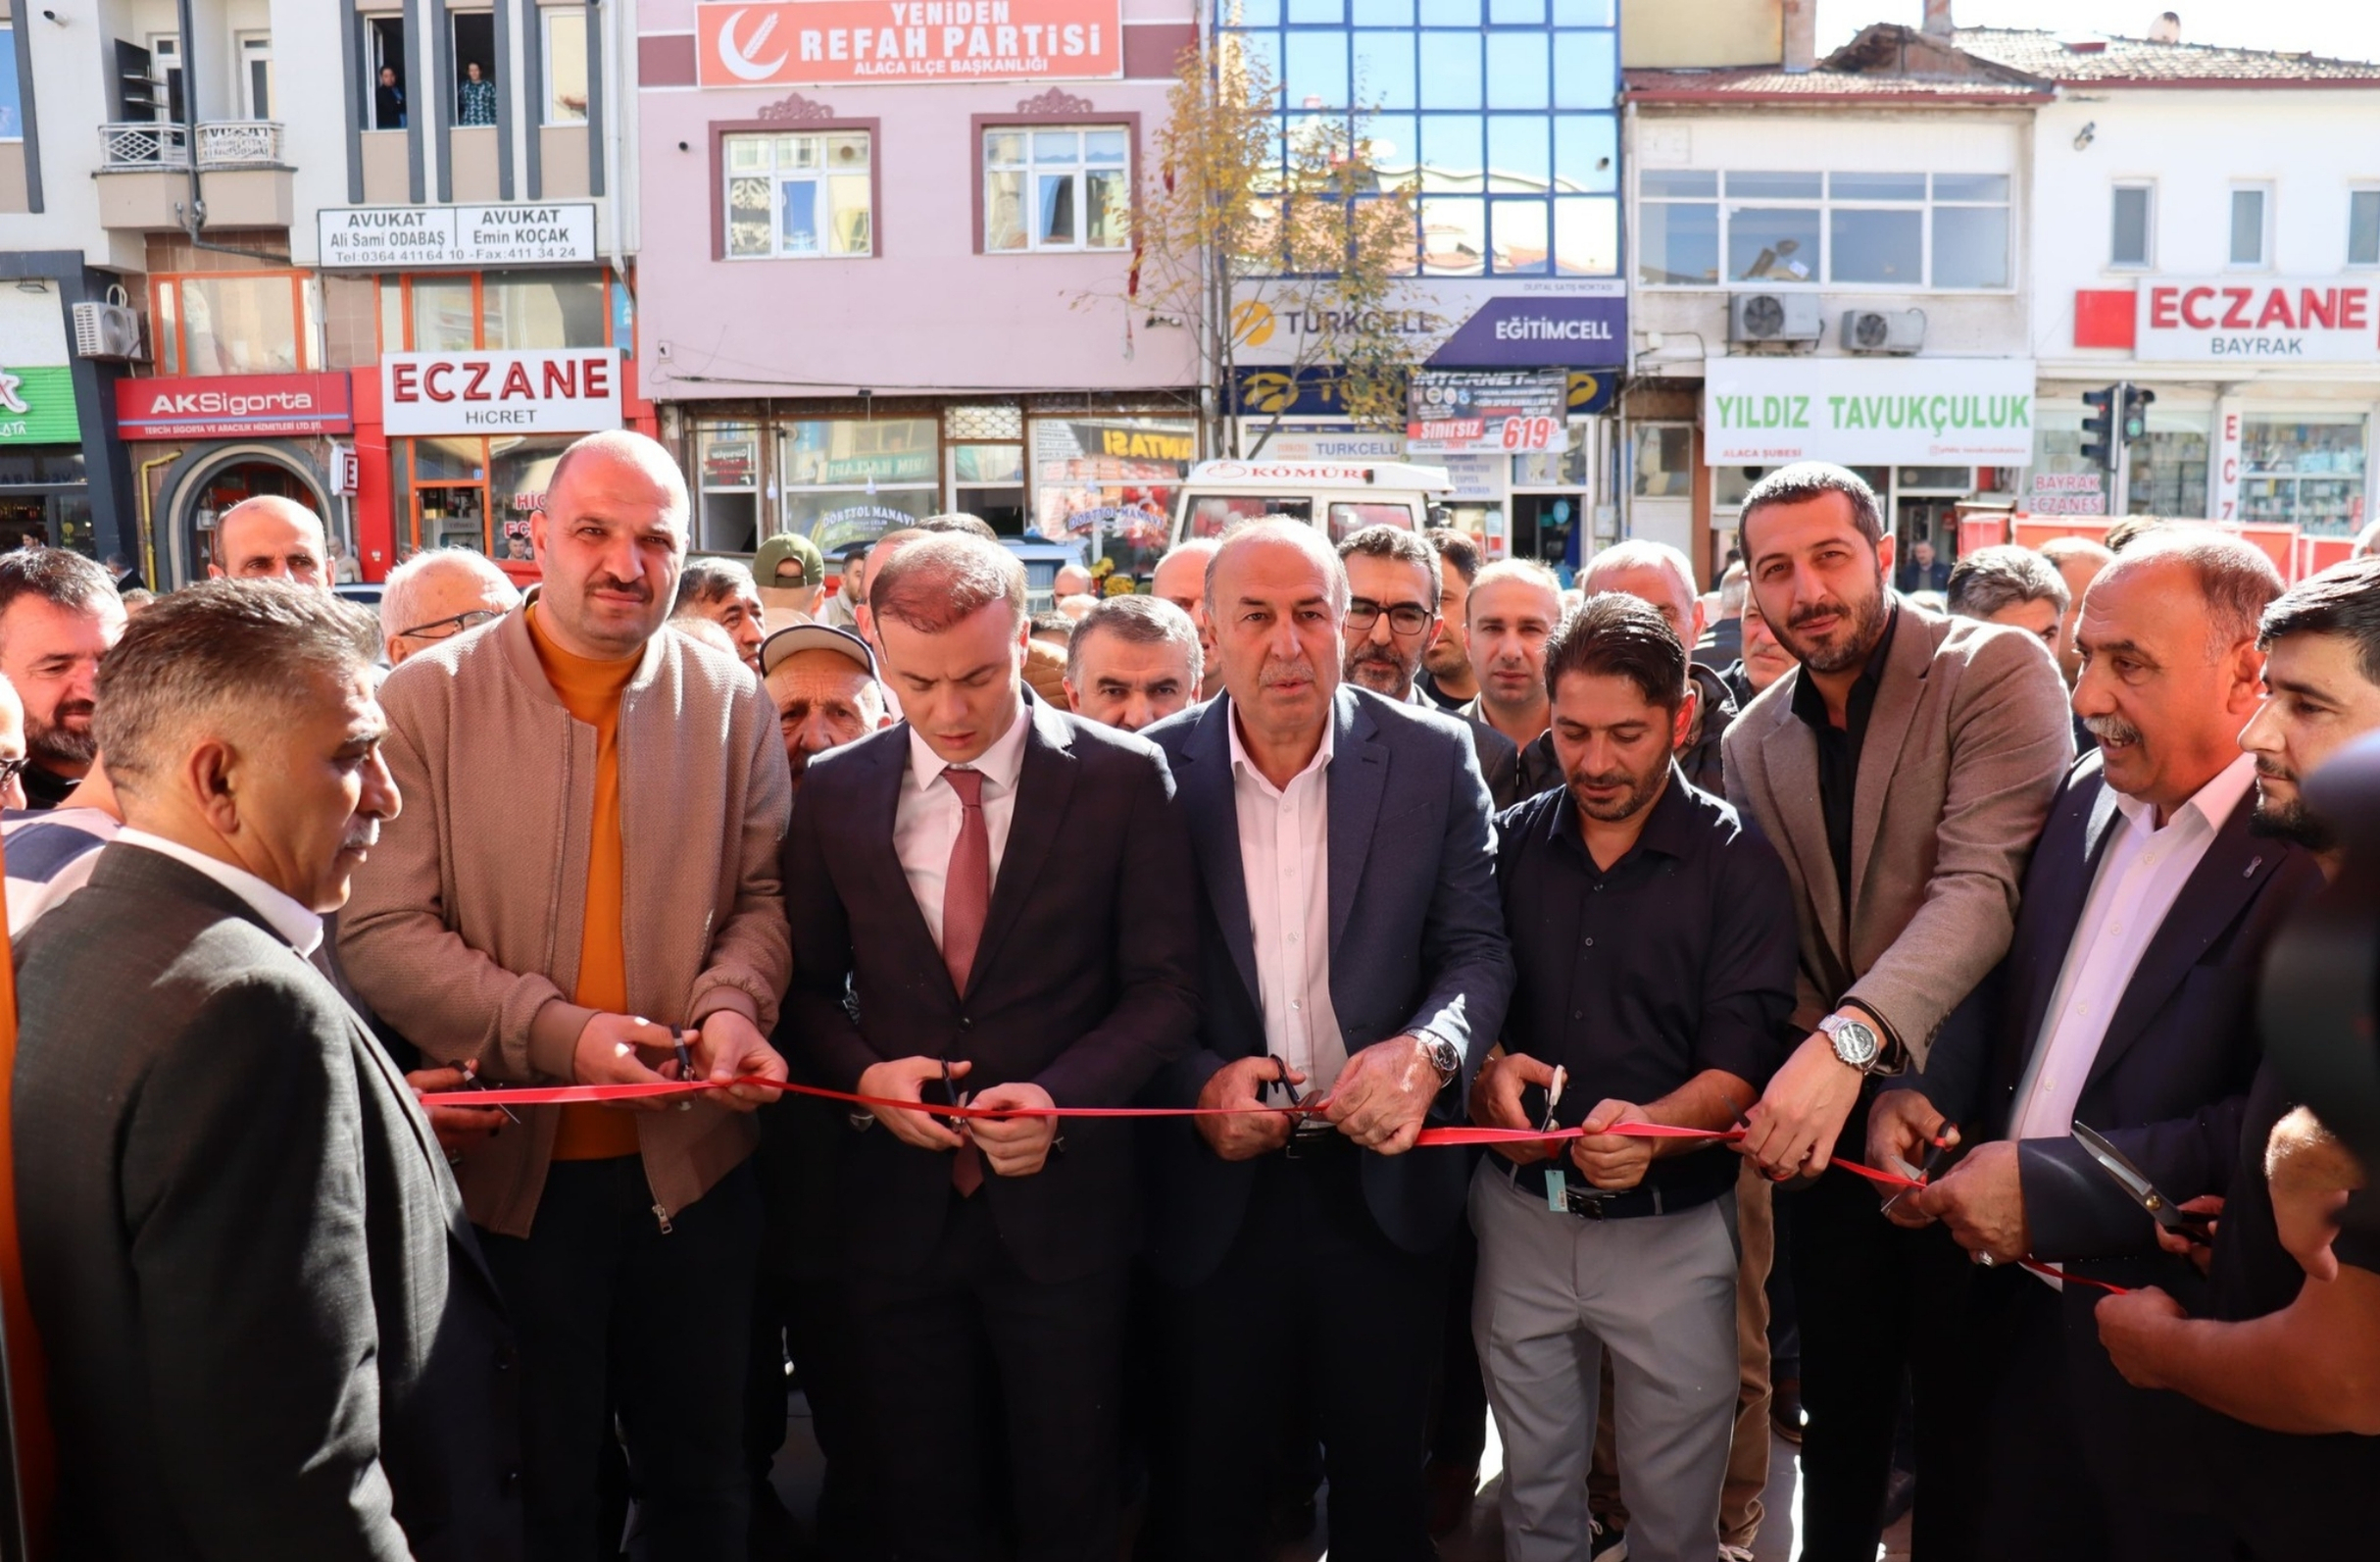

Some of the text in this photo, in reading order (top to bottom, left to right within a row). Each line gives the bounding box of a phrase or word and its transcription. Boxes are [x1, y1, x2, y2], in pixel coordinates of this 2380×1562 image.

[800, 27, 927, 62] REFAH
[854, 59, 907, 76] ALACA
[950, 57, 1049, 76] BAŞKANLIĞI
[347, 212, 427, 228] AVUKAT
[481, 209, 562, 226] AVUKAT
[329, 229, 446, 248] Ali Sami ODABAŞ
[472, 227, 570, 247] Emin KOÇAK
[538, 246, 555, 259] 34
[560, 246, 576, 259] 24
[2151, 286, 2369, 329] ECZANE
[1495, 317, 1612, 341] EĞİTİMCELL
[2211, 337, 2304, 355] BAYRAK
[392, 358, 610, 403] ECZANE
[150, 391, 313, 416] AKSigorta
[1714, 395, 2030, 437] YILDIZ TAVUKÇULUK
[207, 424, 217, 433] VE
[218, 423, 252, 433] ARACILIK
[1314, 442, 1399, 456] TURKCELL
[1722, 448, 1760, 458] ALACA
[346, 464, 357, 486] E
[1251, 465, 1363, 479] KÖMÜR
[2035, 475, 2100, 491] BAYRAK
[515, 489, 547, 511] HİC
